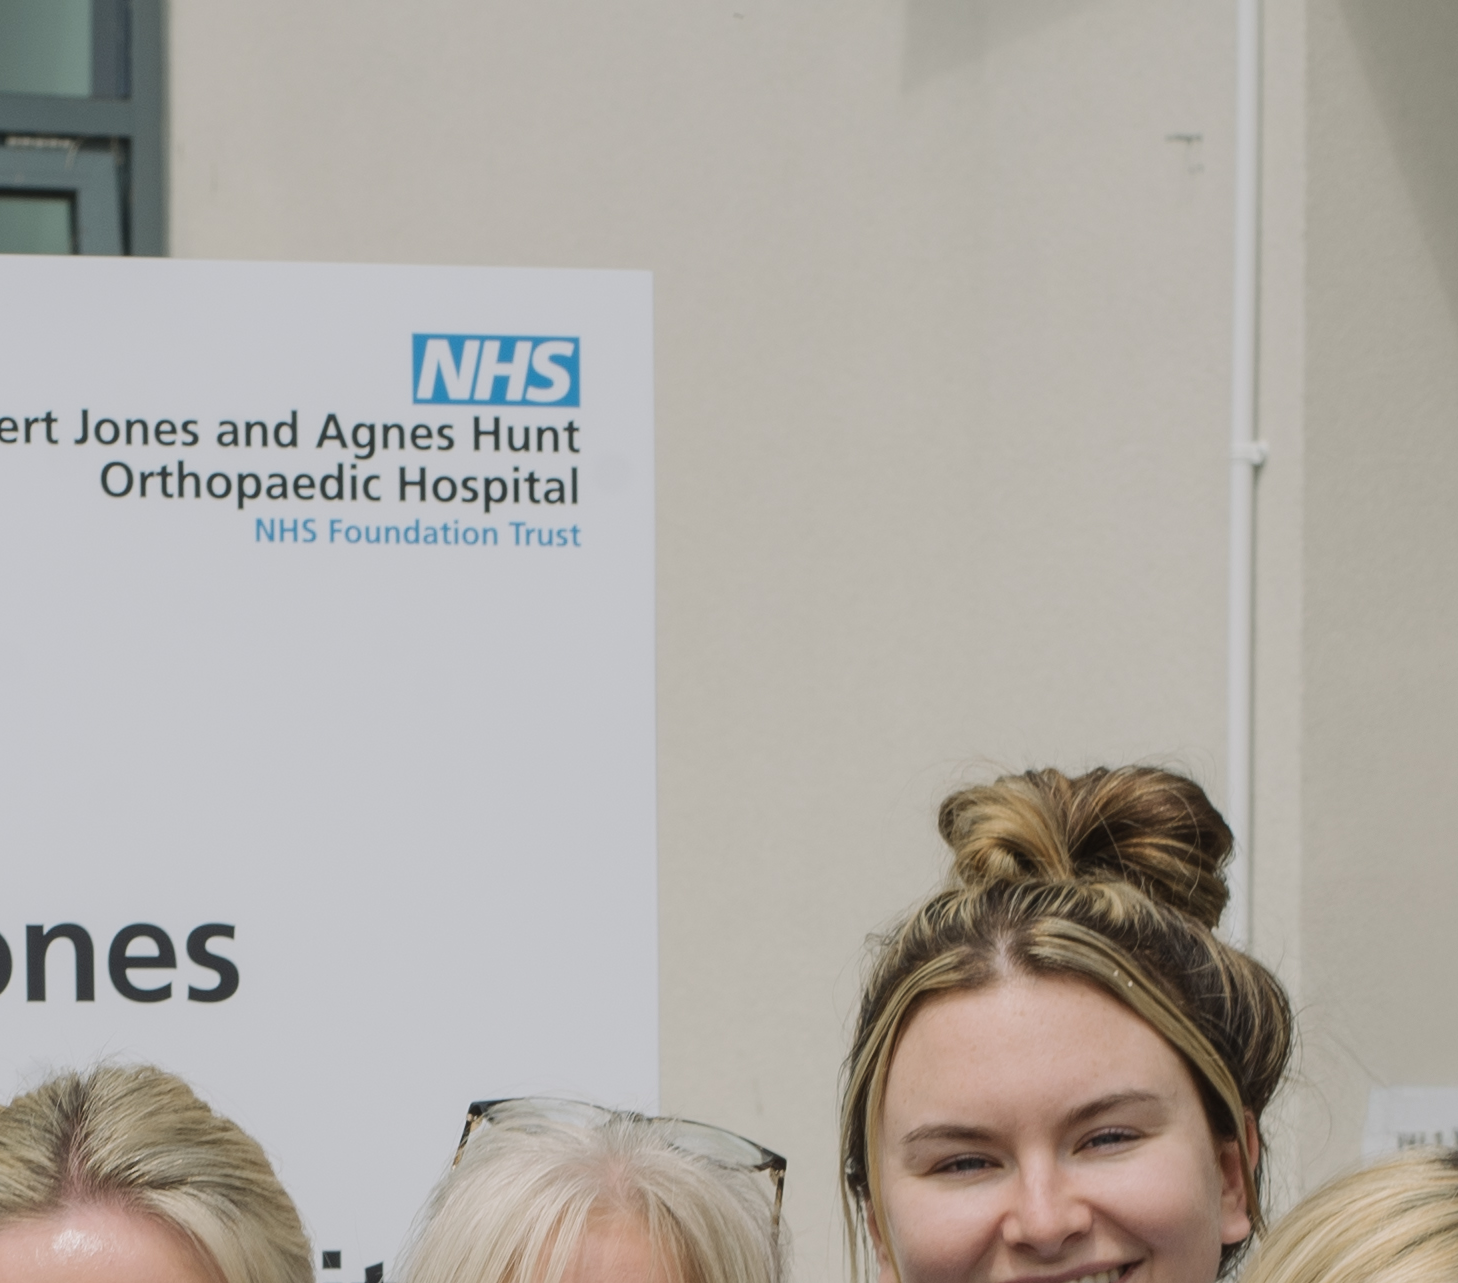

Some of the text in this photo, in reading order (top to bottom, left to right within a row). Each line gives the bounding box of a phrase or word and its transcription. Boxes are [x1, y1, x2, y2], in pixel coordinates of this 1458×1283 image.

[415, 336, 575, 404] NHS
[74, 408, 200, 448] Jones
[217, 410, 298, 449] and
[316, 413, 454, 459] Agnes
[473, 416, 581, 453] Hunt
[100, 460, 579, 514] Orthopaedic Hospital
[255, 517, 581, 547] NHS Foundation Trust
